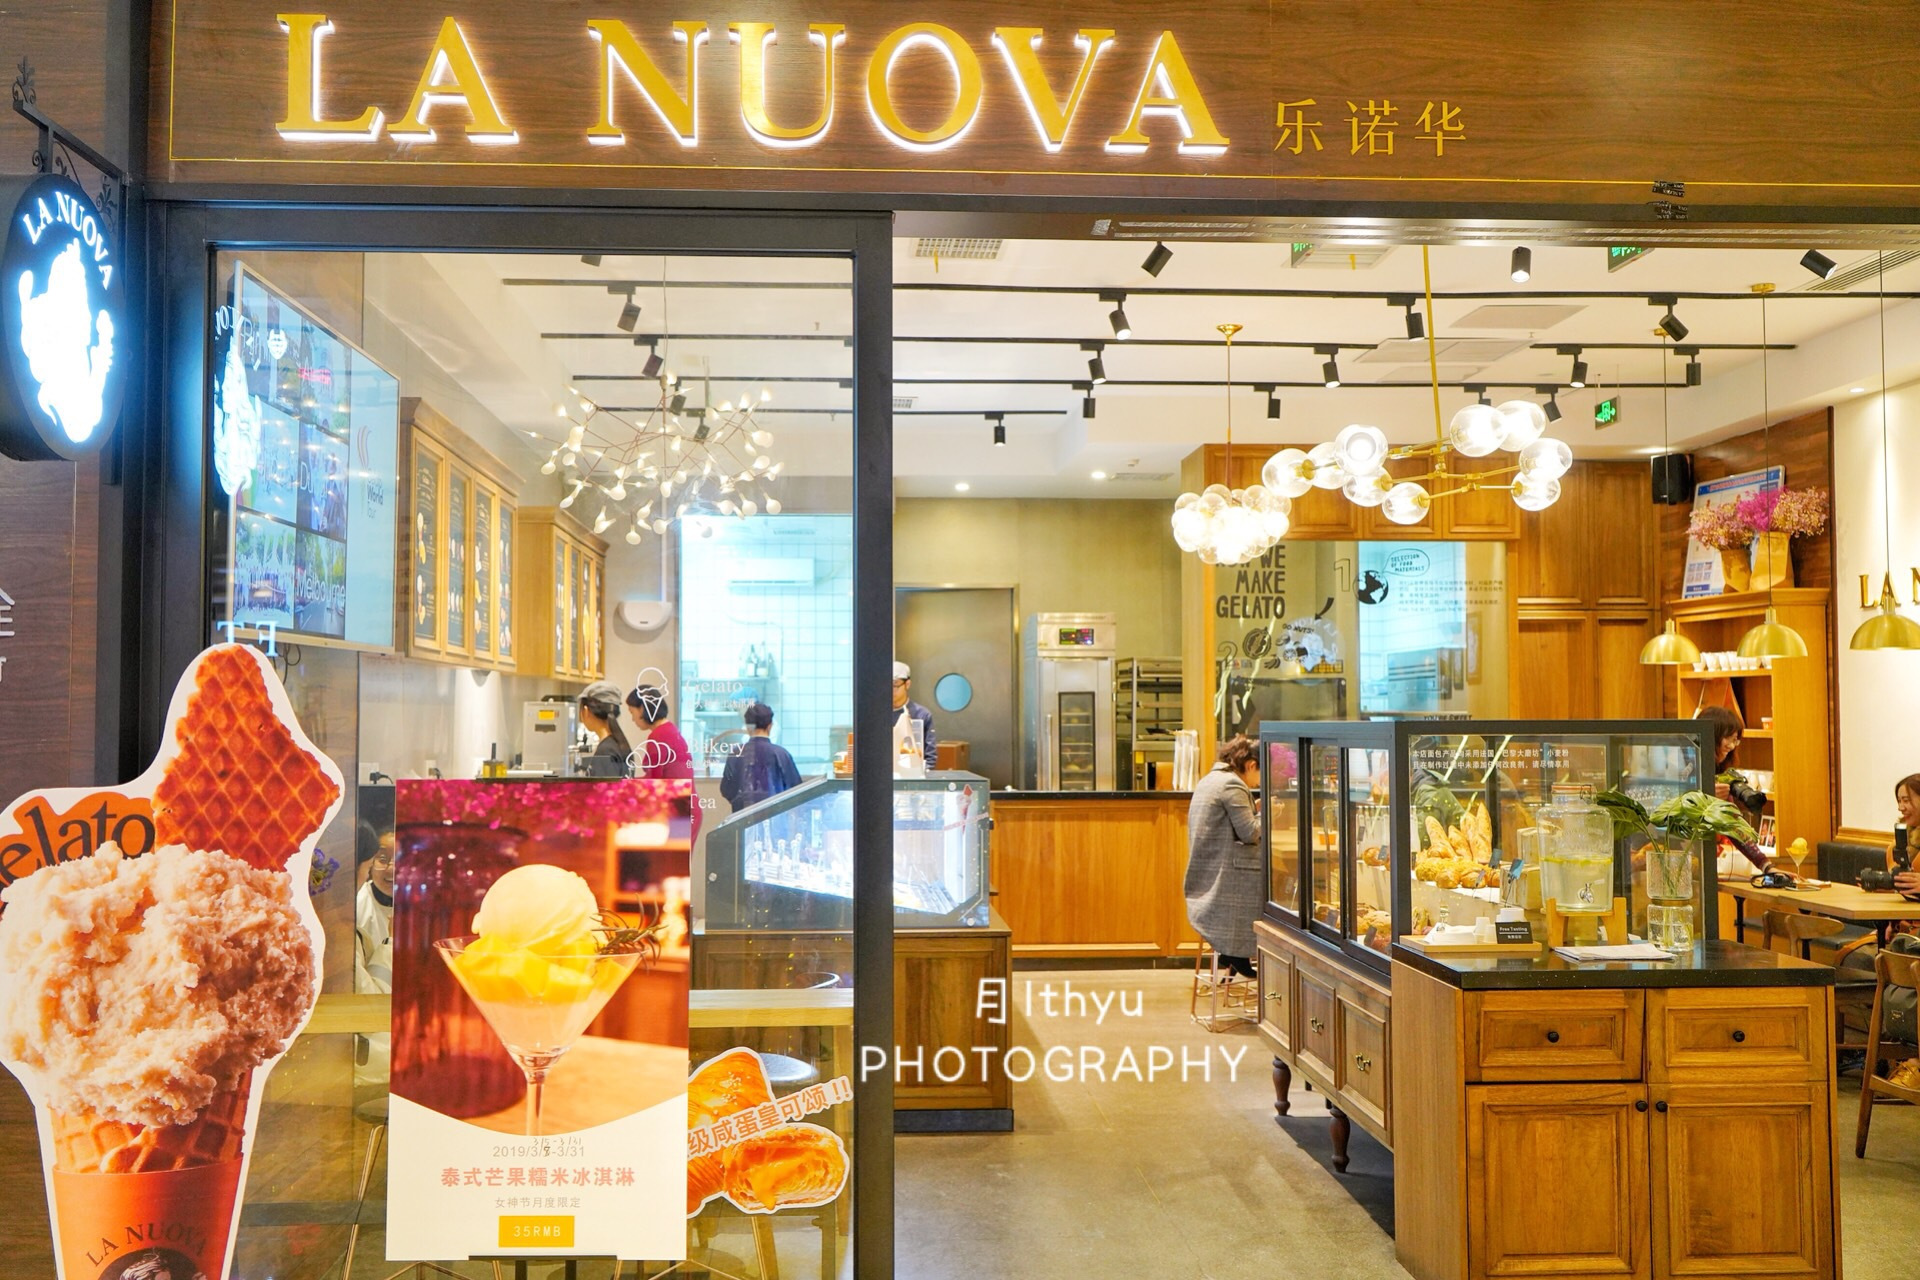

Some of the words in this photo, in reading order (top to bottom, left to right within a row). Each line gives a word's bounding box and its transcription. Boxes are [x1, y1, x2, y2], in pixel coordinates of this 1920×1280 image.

[275, 14, 520, 144] LA
[587, 19, 1230, 156] NUOVA
[1273, 98, 1467, 157] 乐诺华
[22, 197, 54, 246] LA
[54, 190, 114, 291] NUOVA
[1235, 570, 1286, 594] MAKE
[1216, 595, 1286, 619] GELATO
[685, 677, 743, 693] Gelato
[685, 737, 746, 757] Bakery
[440, 1166, 636, 1188] 泰式芒果糯米冰淇淋
[494, 1196, 582, 1209] 女神节月度限定
[85, 1237, 119, 1267] LA
[124, 1222, 209, 1257] NUOVA
